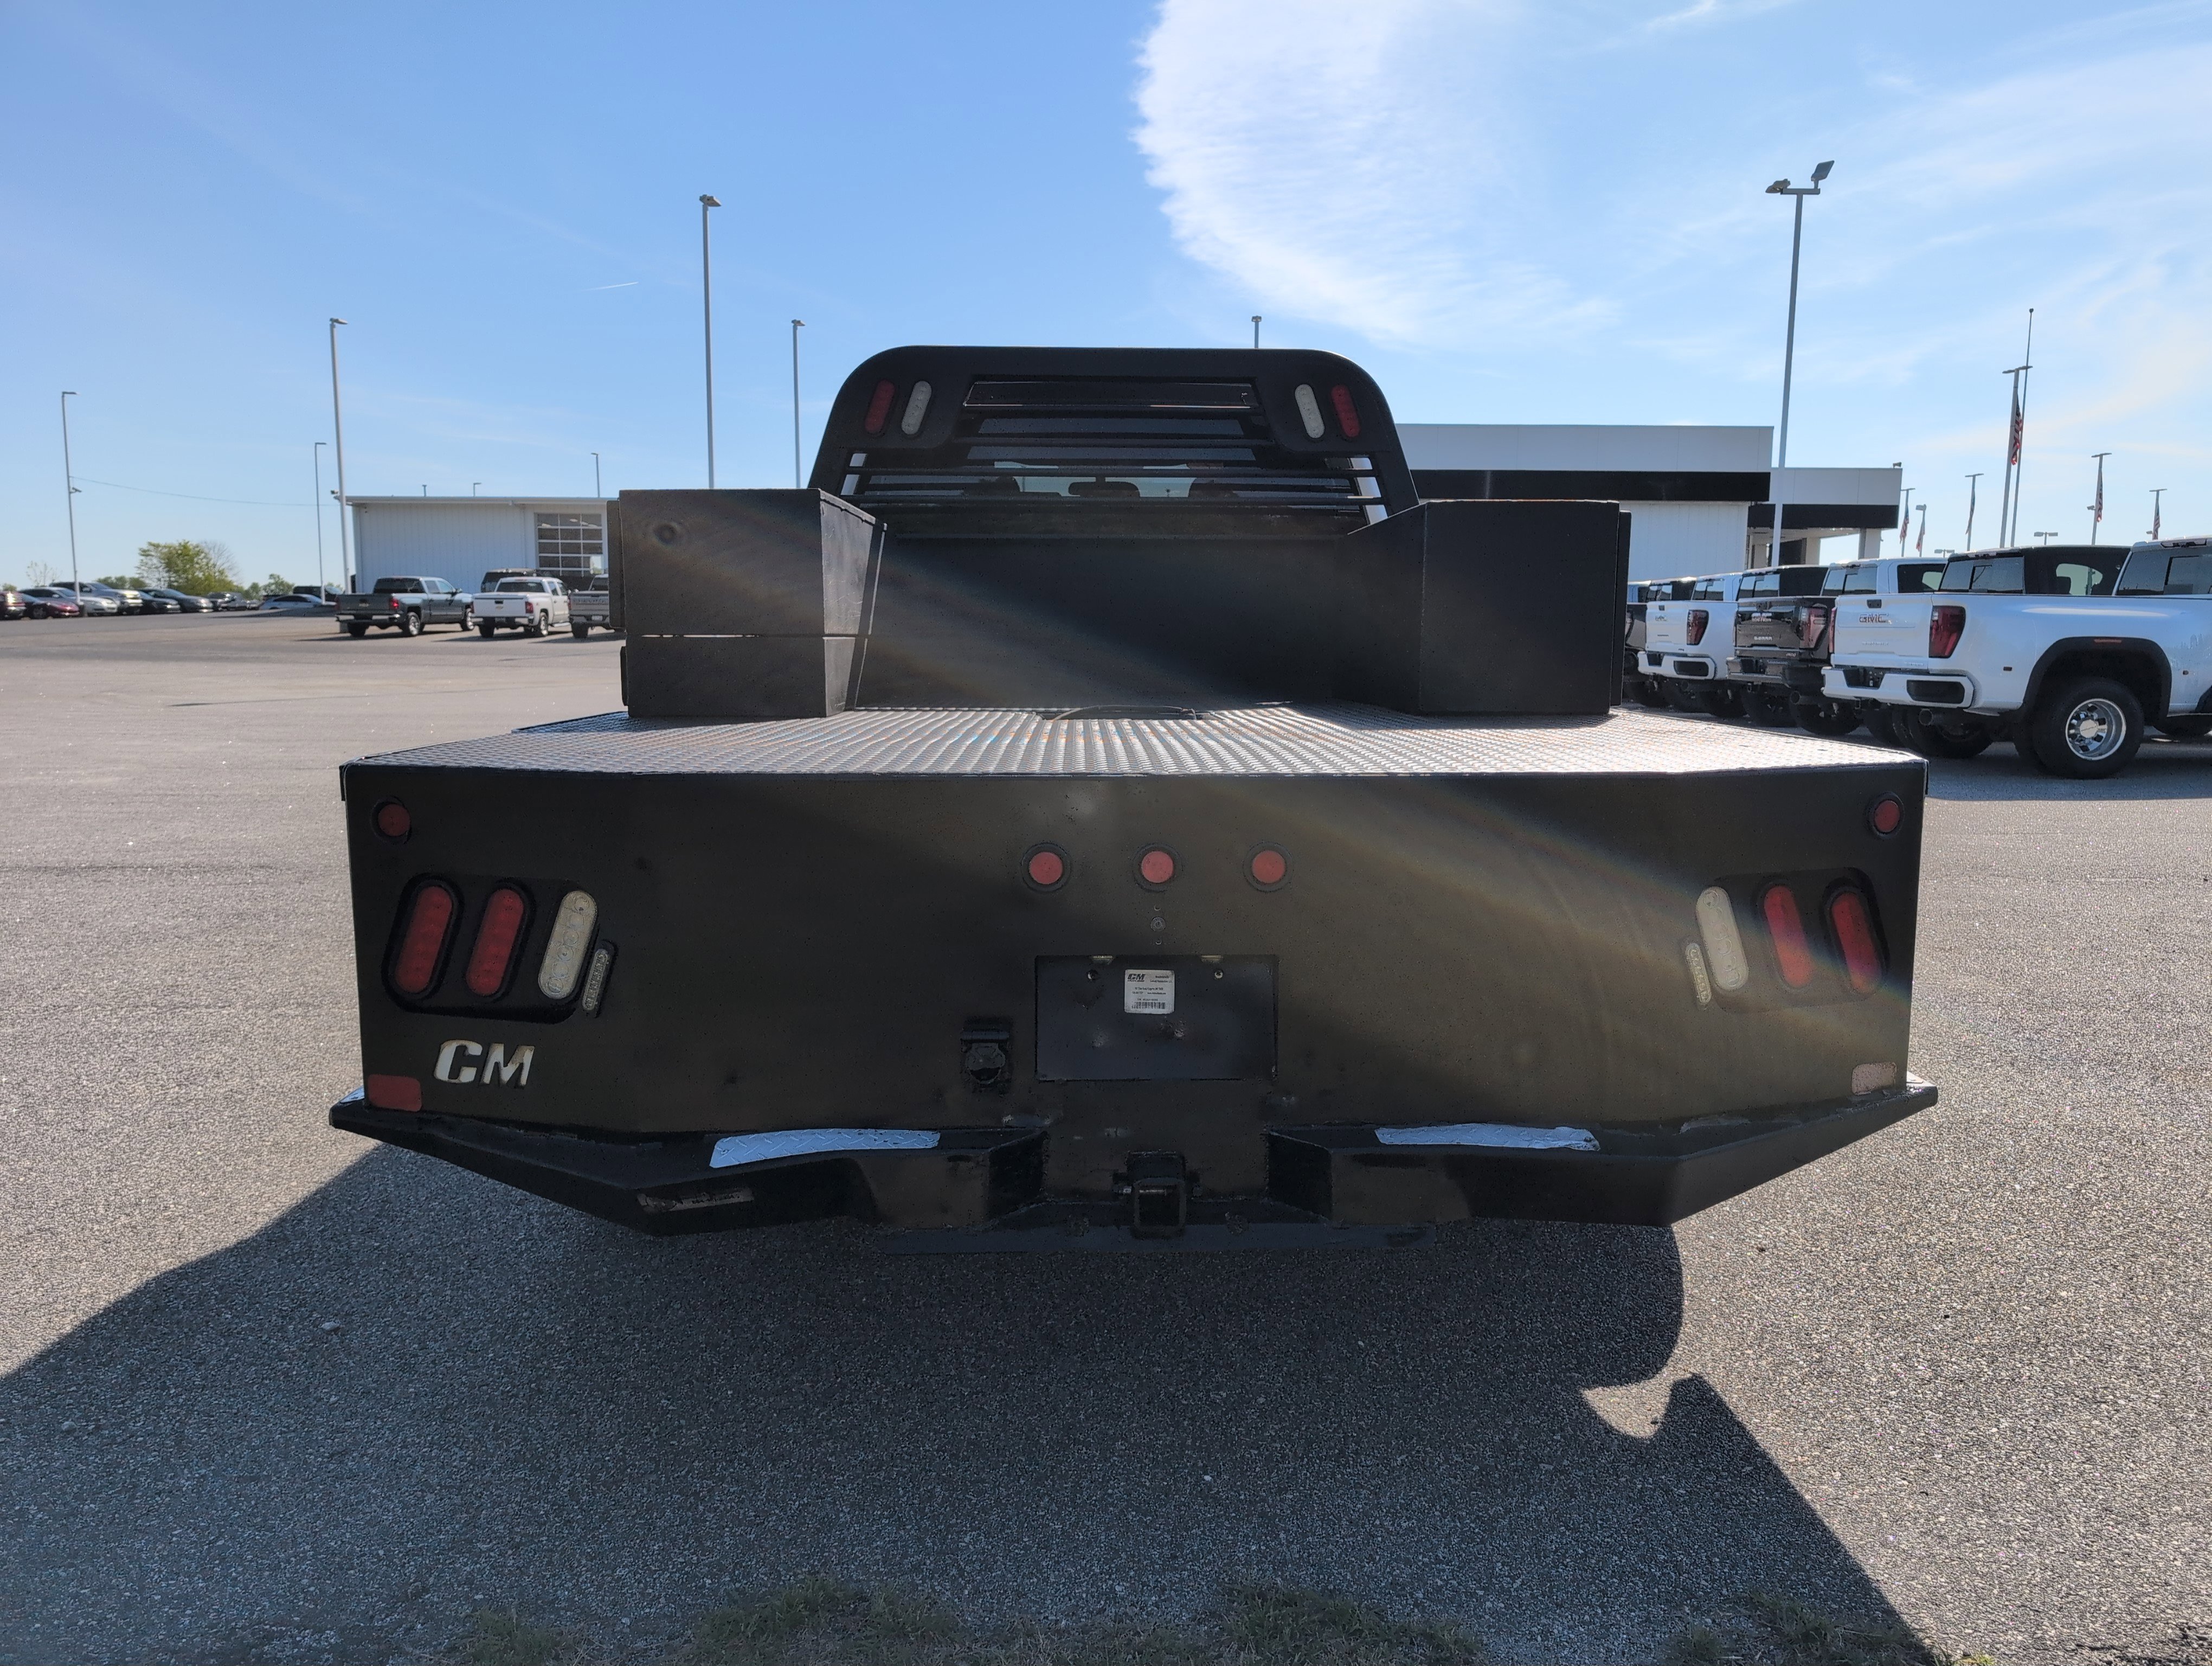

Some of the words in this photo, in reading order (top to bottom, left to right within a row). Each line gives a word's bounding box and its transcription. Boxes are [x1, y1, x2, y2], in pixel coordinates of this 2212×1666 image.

[1752, 612, 1772, 622] GMC
[1859, 613, 1889, 623] GMC
[434, 1040, 535, 1087] CM
